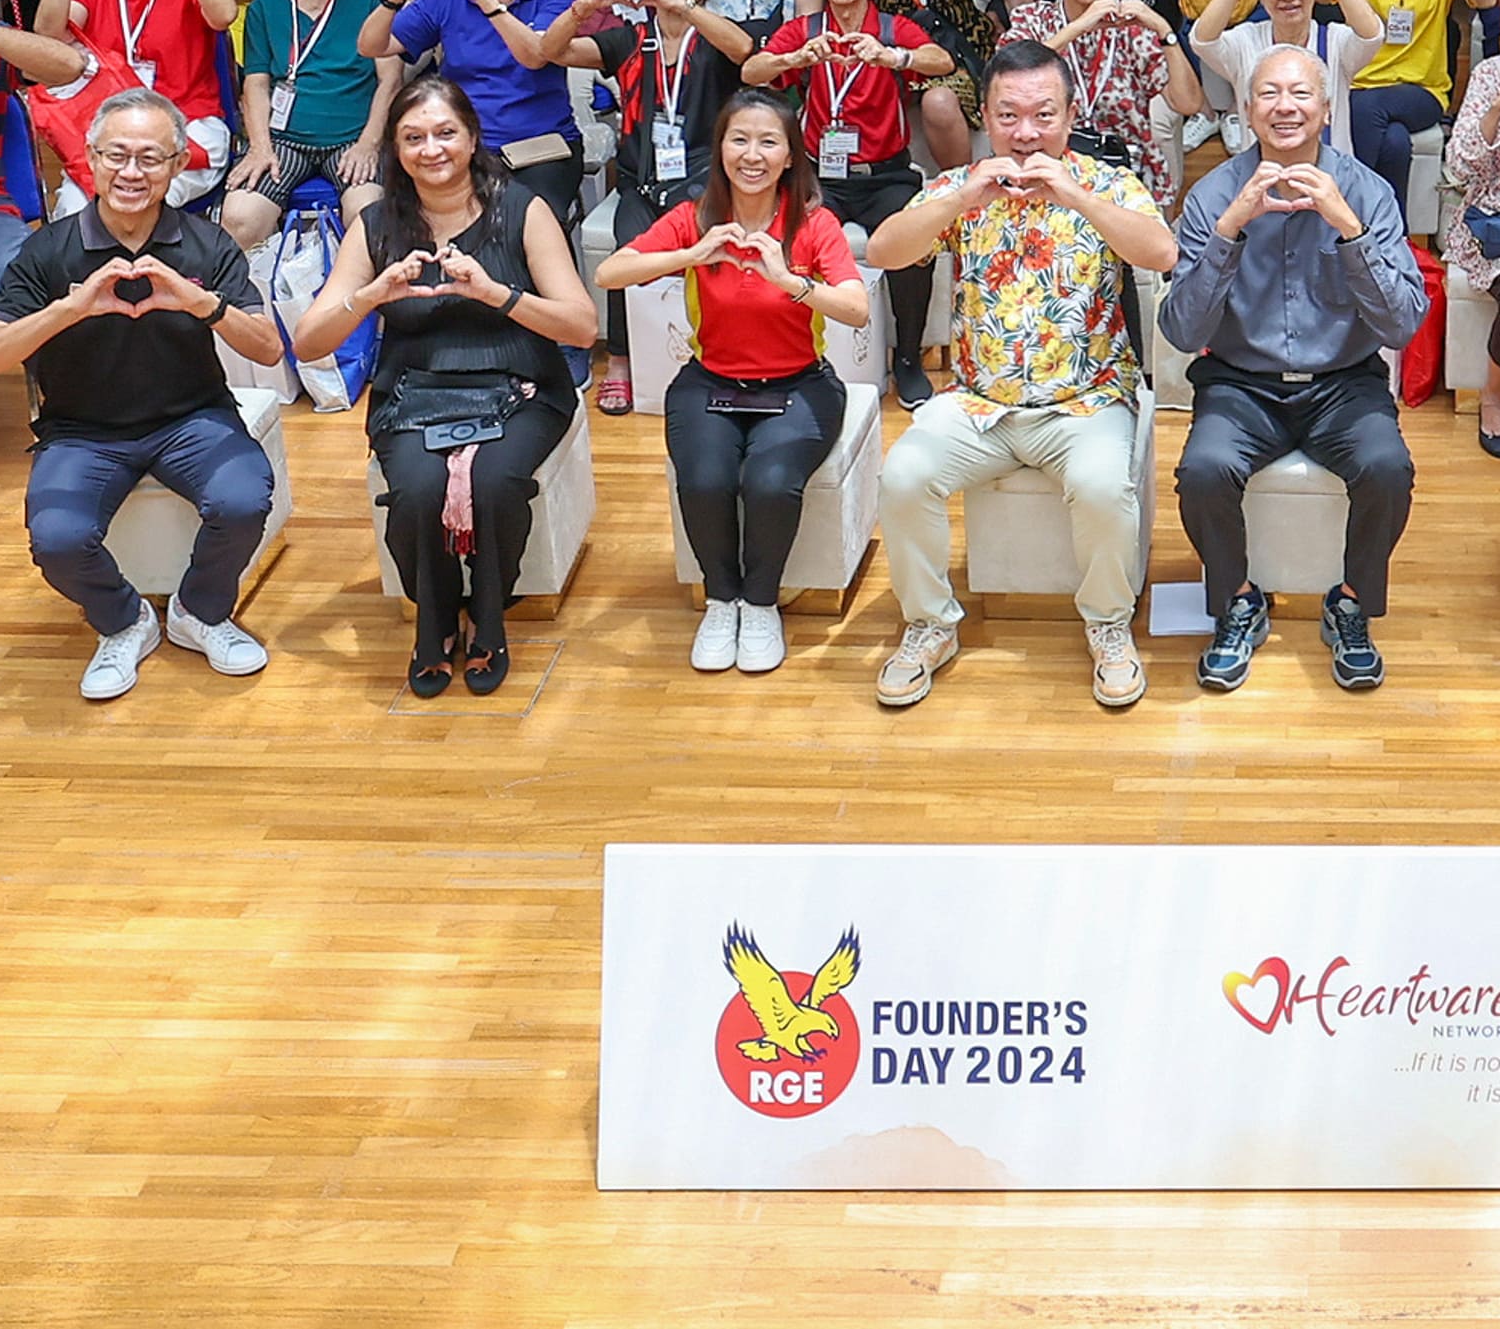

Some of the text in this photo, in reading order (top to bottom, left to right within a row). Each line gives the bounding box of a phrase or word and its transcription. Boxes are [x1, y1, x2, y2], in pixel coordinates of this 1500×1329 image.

[871, 999, 1089, 1037] FOUNDER'S
[871, 1046, 1087, 1085] DAY 2024
[1429, 1052, 1443, 1073] it
[1449, 1052, 1466, 1073] is
[747, 1069, 825, 1106] RGE
[1466, 1083, 1480, 1104] it
